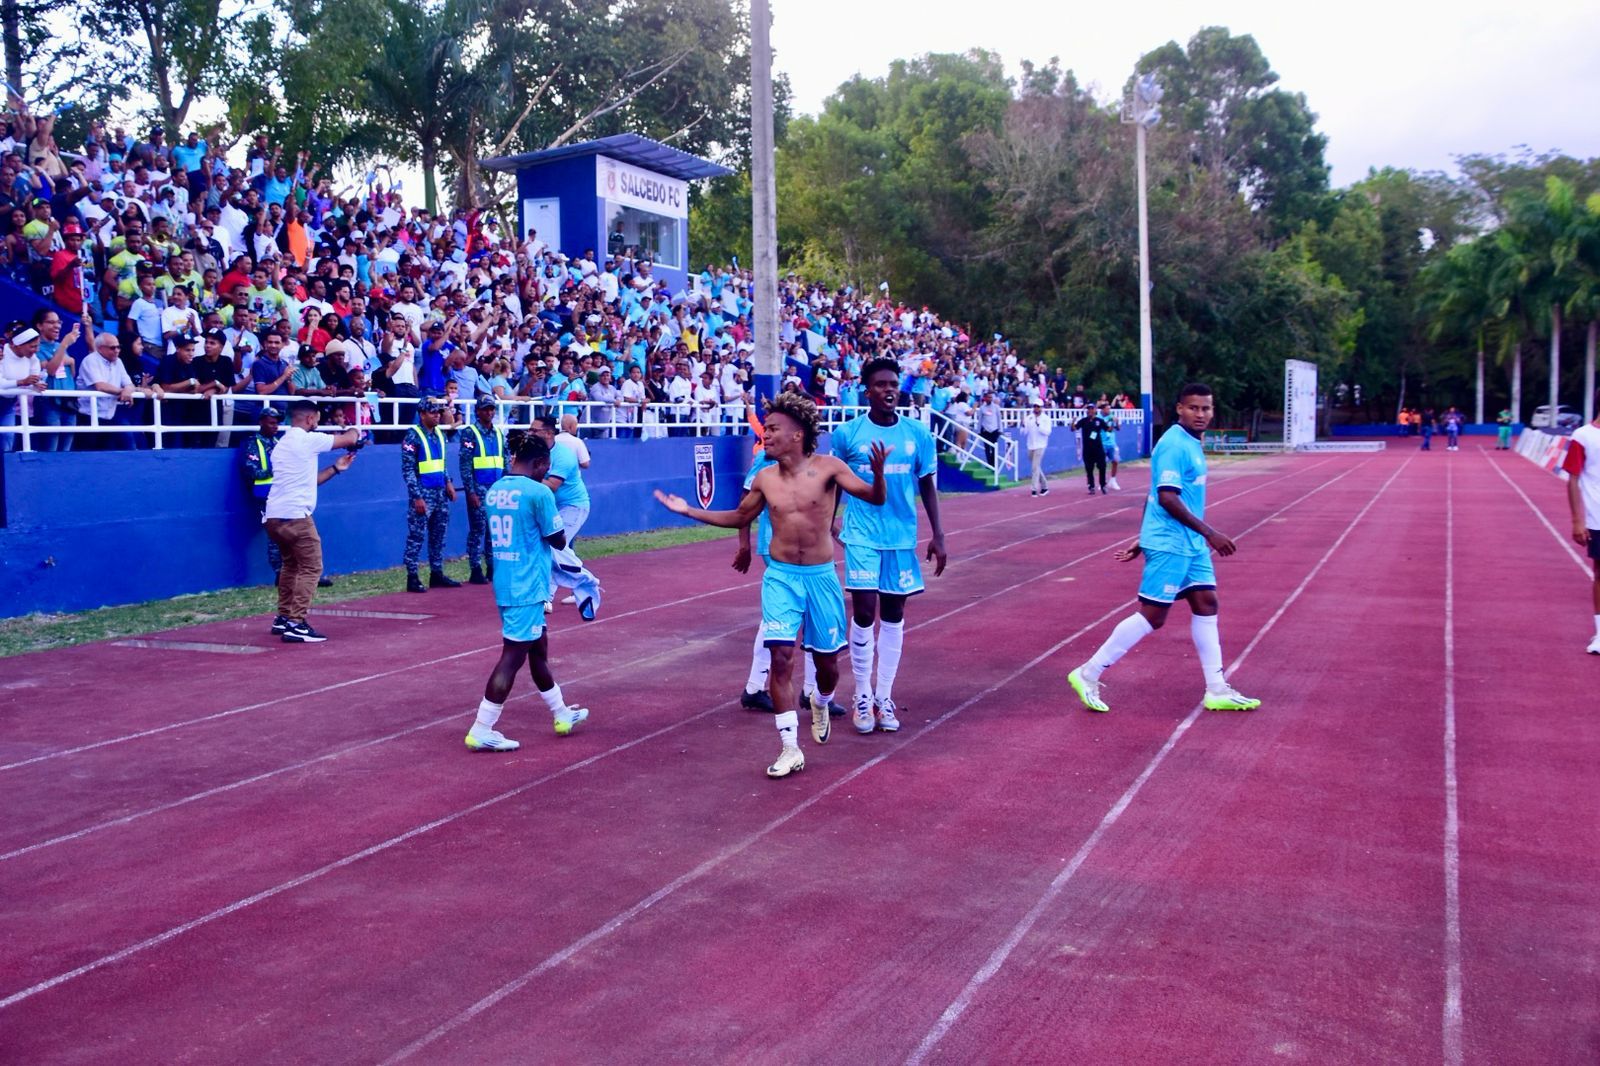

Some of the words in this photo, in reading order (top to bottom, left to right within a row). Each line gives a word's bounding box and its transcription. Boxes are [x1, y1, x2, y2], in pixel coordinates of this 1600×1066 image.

[620, 172, 666, 204] SALCEDO
[668, 186, 680, 208] FC
[486, 489, 522, 508] GBC
[489, 514, 514, 548] 99
[898, 568, 915, 589] 25
[828, 627, 838, 646] 7
